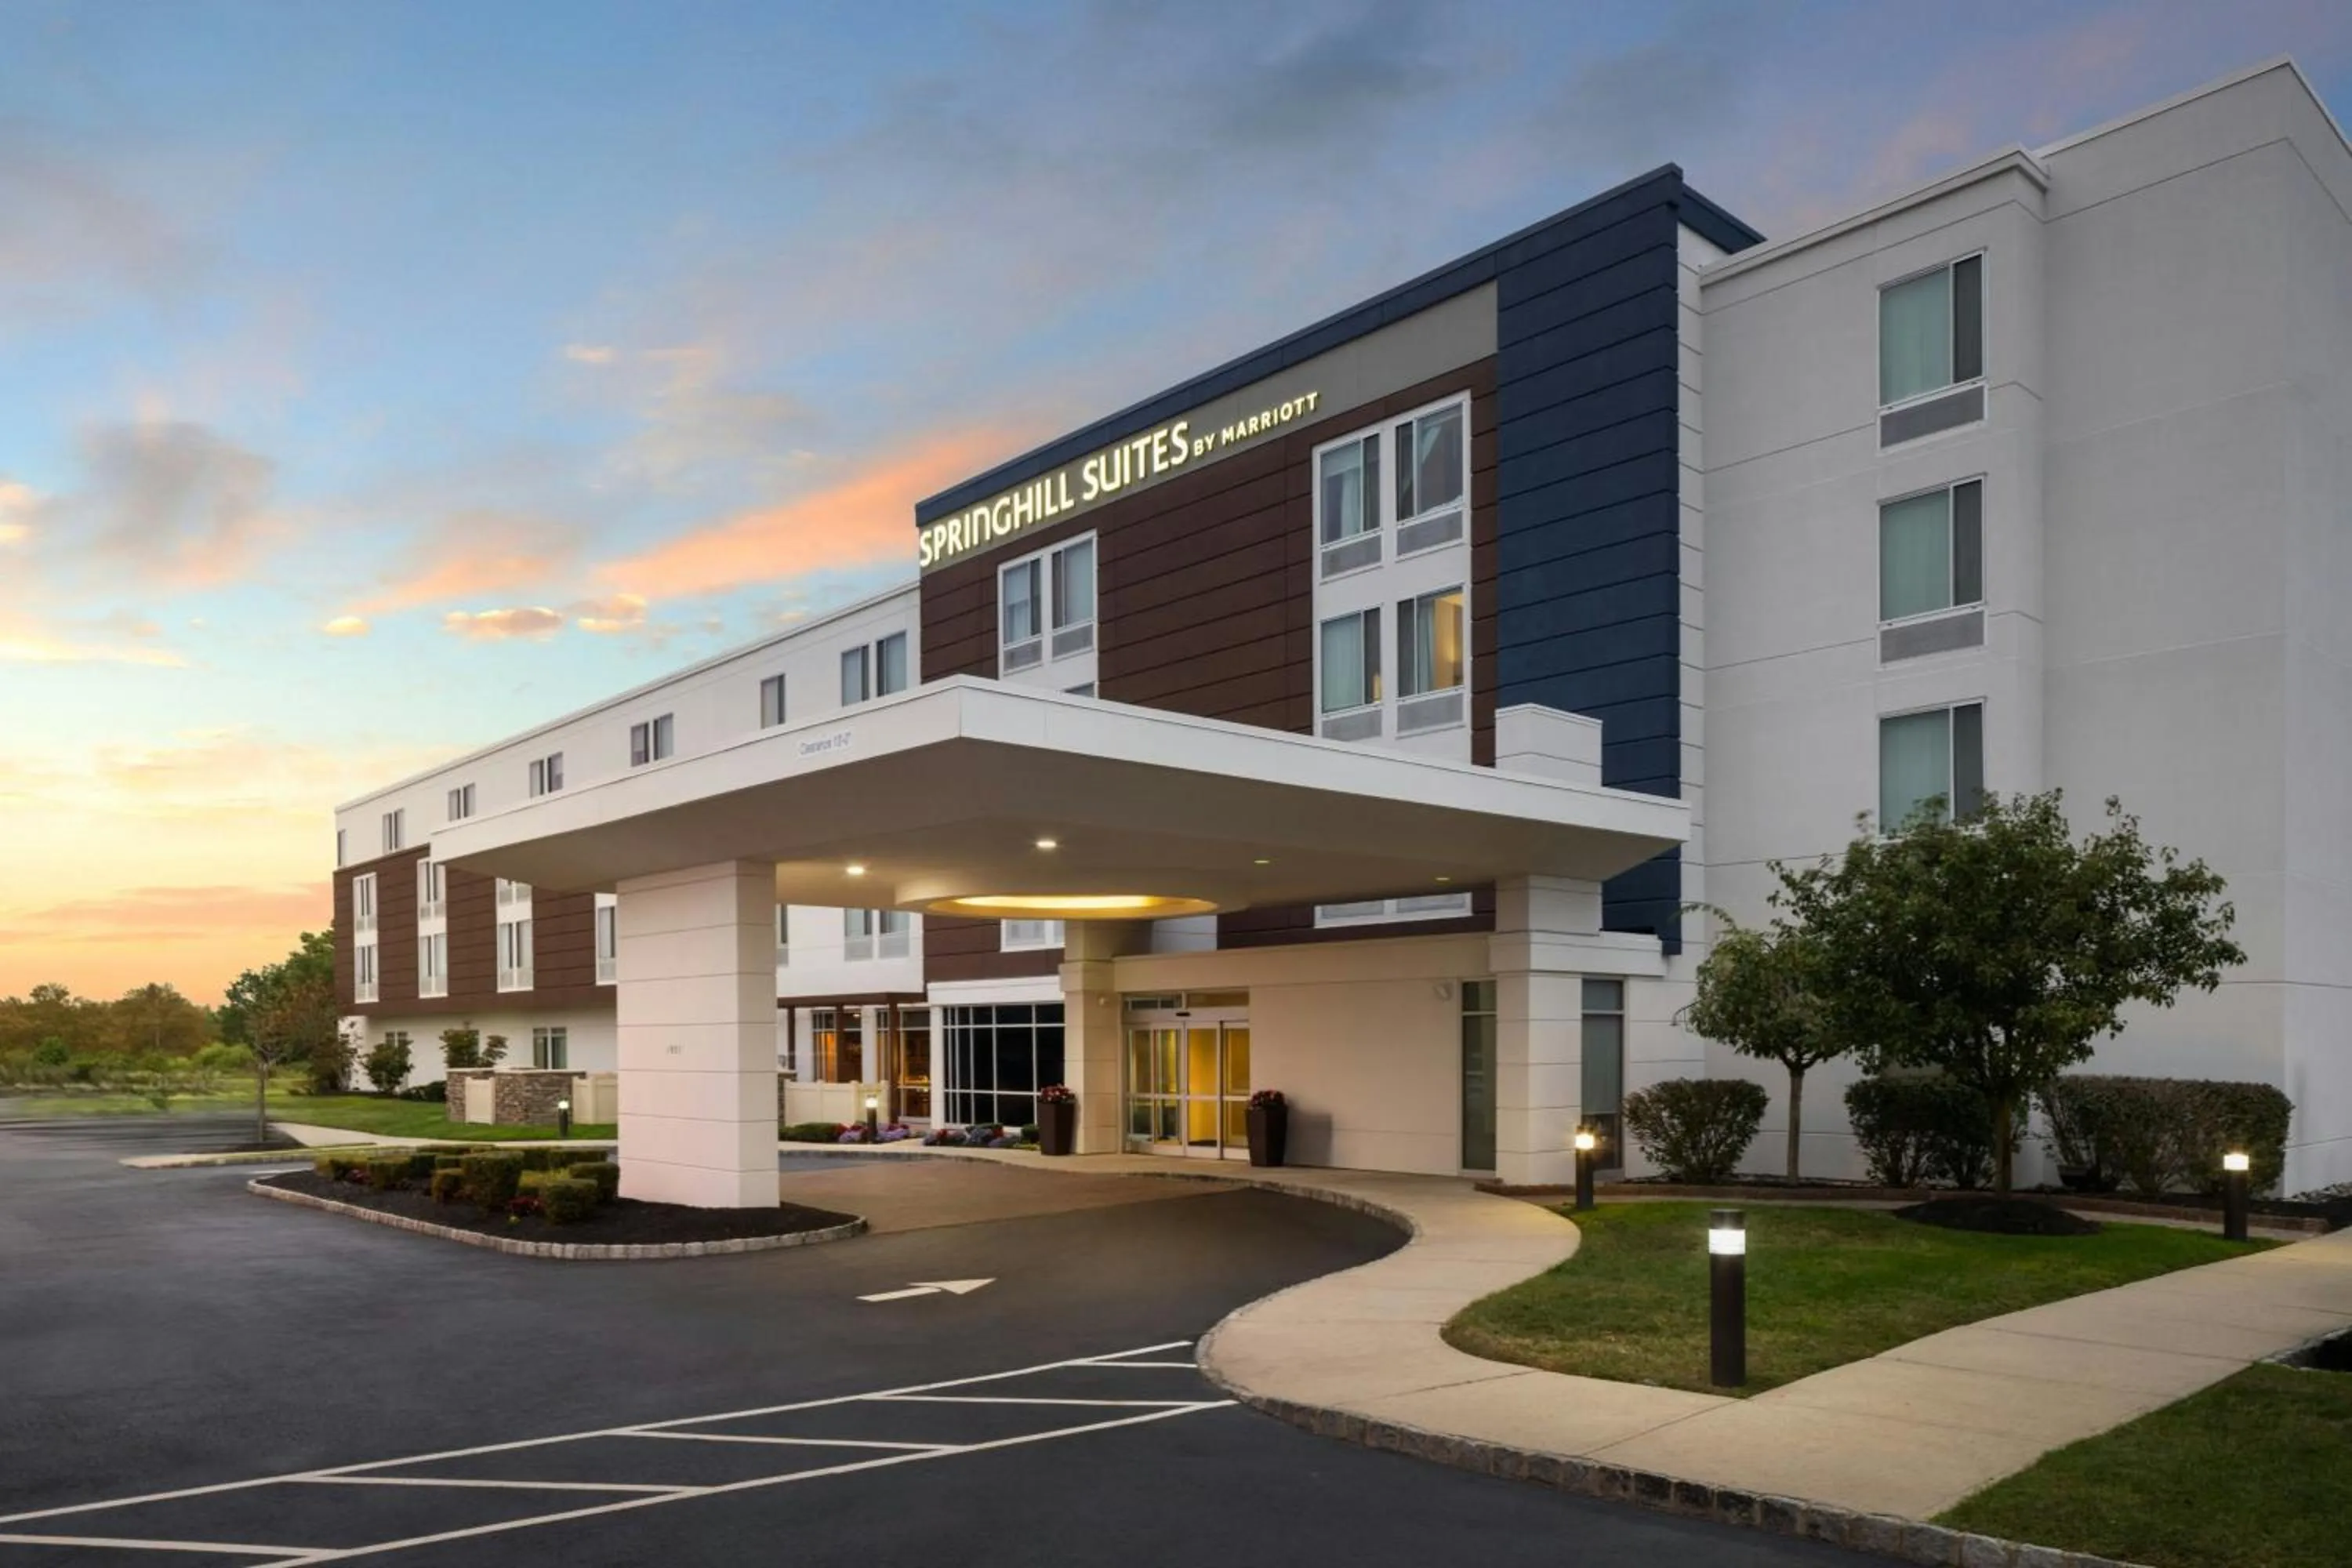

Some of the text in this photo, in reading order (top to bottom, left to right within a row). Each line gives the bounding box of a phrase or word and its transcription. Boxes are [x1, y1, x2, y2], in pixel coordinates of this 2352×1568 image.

[919, 392, 1318, 567] SPRINGHILL SUITES BY MARRIOTT
